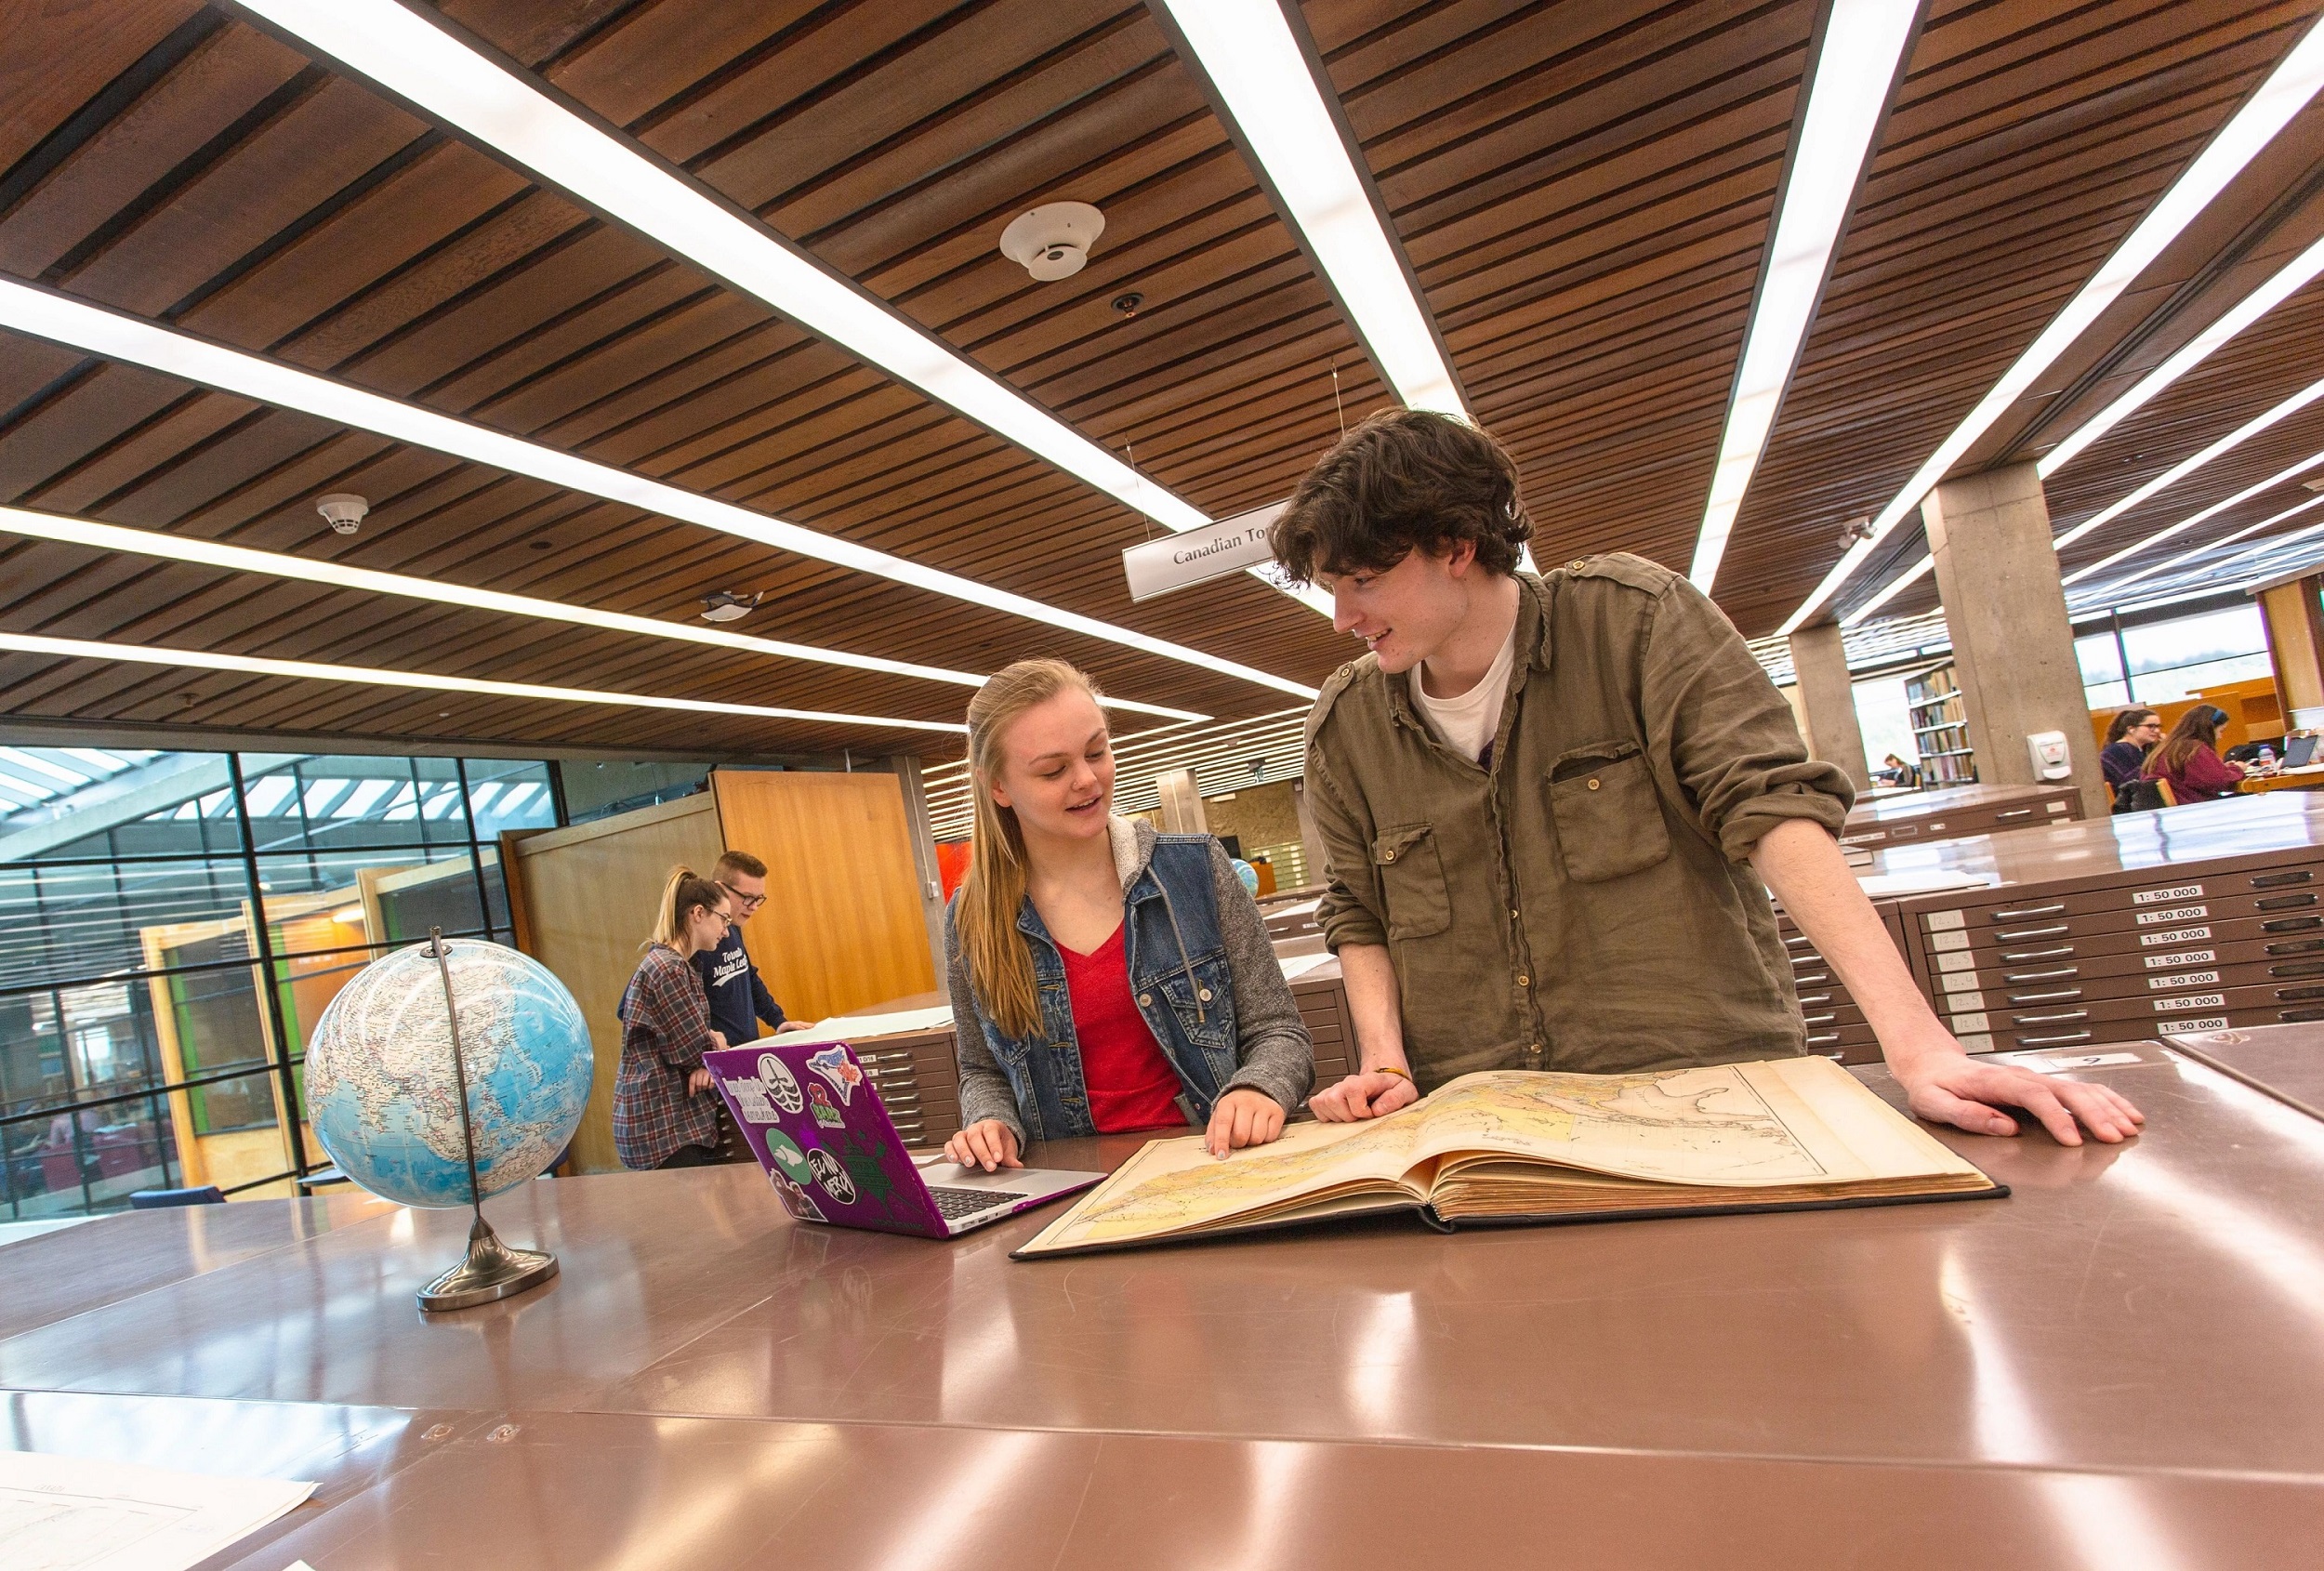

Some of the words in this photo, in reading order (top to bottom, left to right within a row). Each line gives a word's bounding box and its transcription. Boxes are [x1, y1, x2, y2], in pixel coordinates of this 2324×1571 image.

[1173, 537, 1242, 564] Canadian
[1246, 528, 1265, 542] To
[2138, 893, 2150, 902] 1:
[2154, 891, 2170, 900] 50
[2173, 887, 2198, 897] 000
[2158, 911, 2173, 920] 50
[2177, 907, 2201, 918] 000
[1933, 914, 1957, 927] 12.1
[1938, 933, 1965, 944] 12.2
[2161, 932, 2177, 942] 50
[2181, 929, 2205, 939] 000
[1945, 954, 1970, 967] 12.3
[2165, 956, 2181, 964] 50
[2185, 952, 2209, 962] 000
[713, 961, 736, 978] Maple
[1949, 974, 1974, 987] 12.4
[2170, 976, 2185, 985] 50
[2189, 973, 2213, 983] 000
[1955, 994, 1980, 1007] 12.5
[2174, 998, 2190, 1008] 50
[2195, 996, 2219, 1006] 000
[1960, 1016, 1984, 1028] 12.6
[2163, 1023, 2174, 1032] 1:
[2178, 1022, 2194, 1031] 50
[2199, 1019, 2223, 1029] 000
